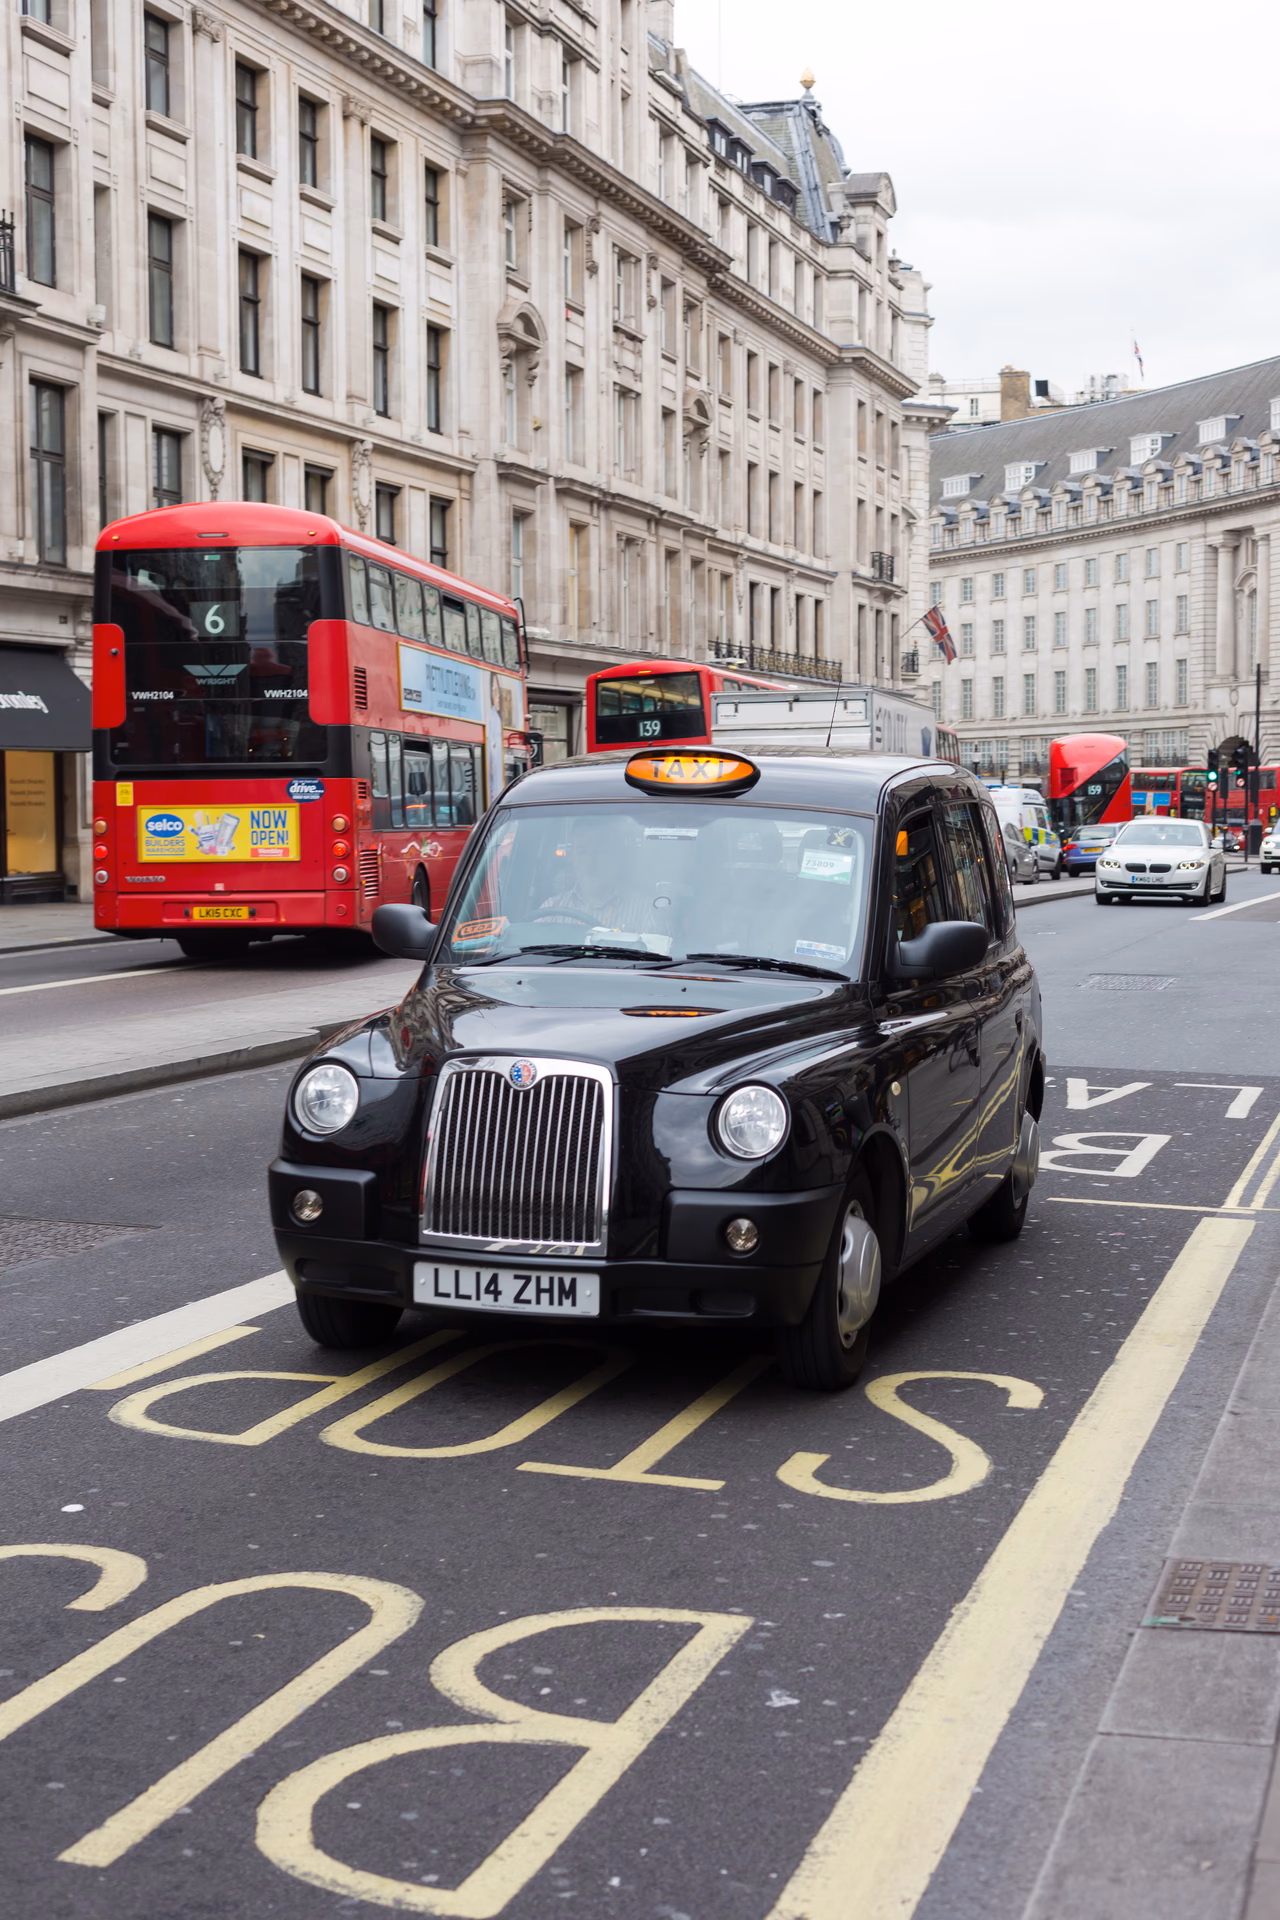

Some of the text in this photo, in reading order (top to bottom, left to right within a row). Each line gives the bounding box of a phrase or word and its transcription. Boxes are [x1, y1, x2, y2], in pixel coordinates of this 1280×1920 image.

[204, 604, 225, 634] 6
[195, 677, 237, 685] WRIGHT
[132, 691, 174, 700] VWH2104
[264, 689, 308, 698] VWH2104
[639, 720, 661, 737] 139
[651, 759, 724, 778] TAXI
[1087, 784, 1102, 796] 159
[147, 818, 184, 832] selco
[250, 809, 288, 829] NOW
[145, 839, 186, 847] BUILDERS
[250, 830, 289, 846] OPEN!
[804, 858, 836, 869] 73809
[125, 875, 167, 883] VOLVO
[198, 908, 243, 918] LK15 CXC
[433, 1267, 578, 1308] LL14 ZHM
[107, 1330, 1044, 1504] STOP
[0, 1543, 754, 1918] BU
